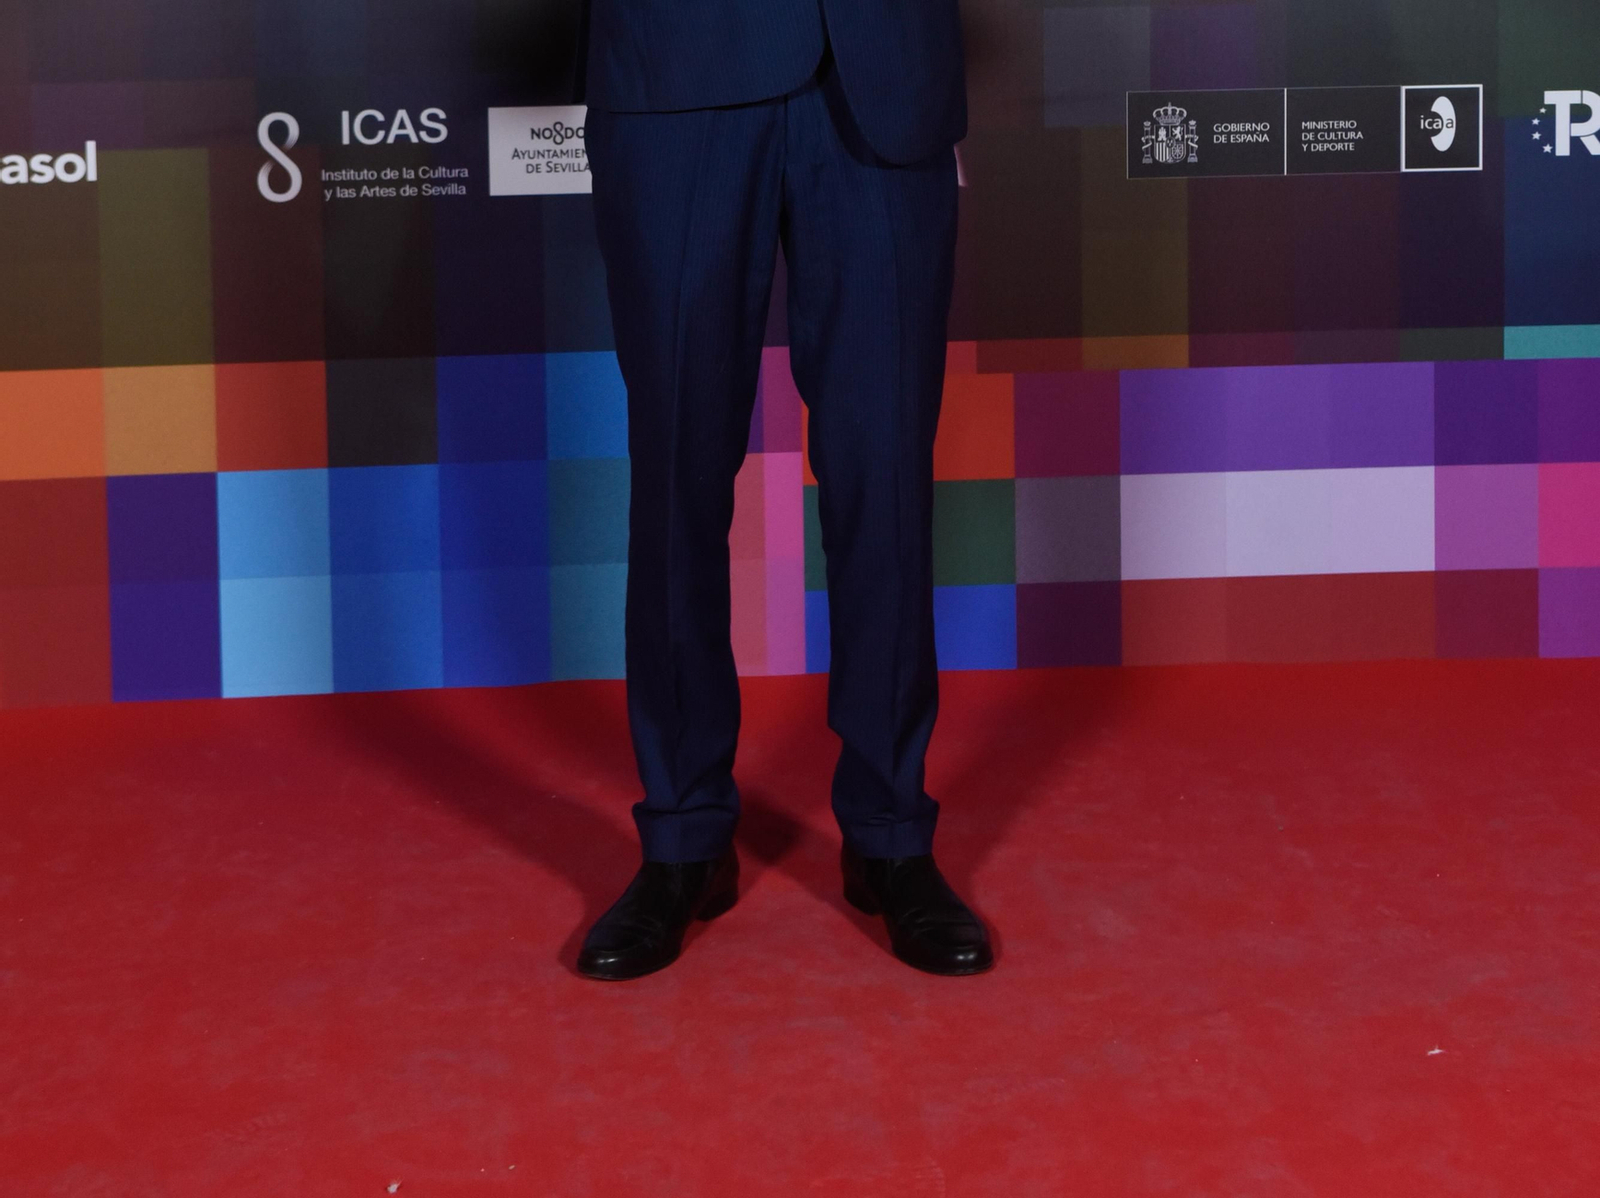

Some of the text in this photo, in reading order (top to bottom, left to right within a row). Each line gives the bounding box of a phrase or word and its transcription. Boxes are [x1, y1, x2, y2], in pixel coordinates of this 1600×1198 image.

[341, 107, 448, 146] ICAS
[1213, 122, 1270, 133] GOBIERNO
[1301, 120, 1357, 130] MINISTERIO
[1420, 115, 1454, 129] icaa
[1213, 132, 1270, 144] DE ESPAÑA
[1301, 131, 1363, 141] DE CULTURA
[1302, 142, 1355, 152] Y DEPORTE
[0, 140, 97, 184] asol
[526, 161, 590, 174] DE SEVILLA
[321, 166, 469, 181] Instituto de la Cultura
[324, 183, 466, 202] y las Artes de Sevilla
